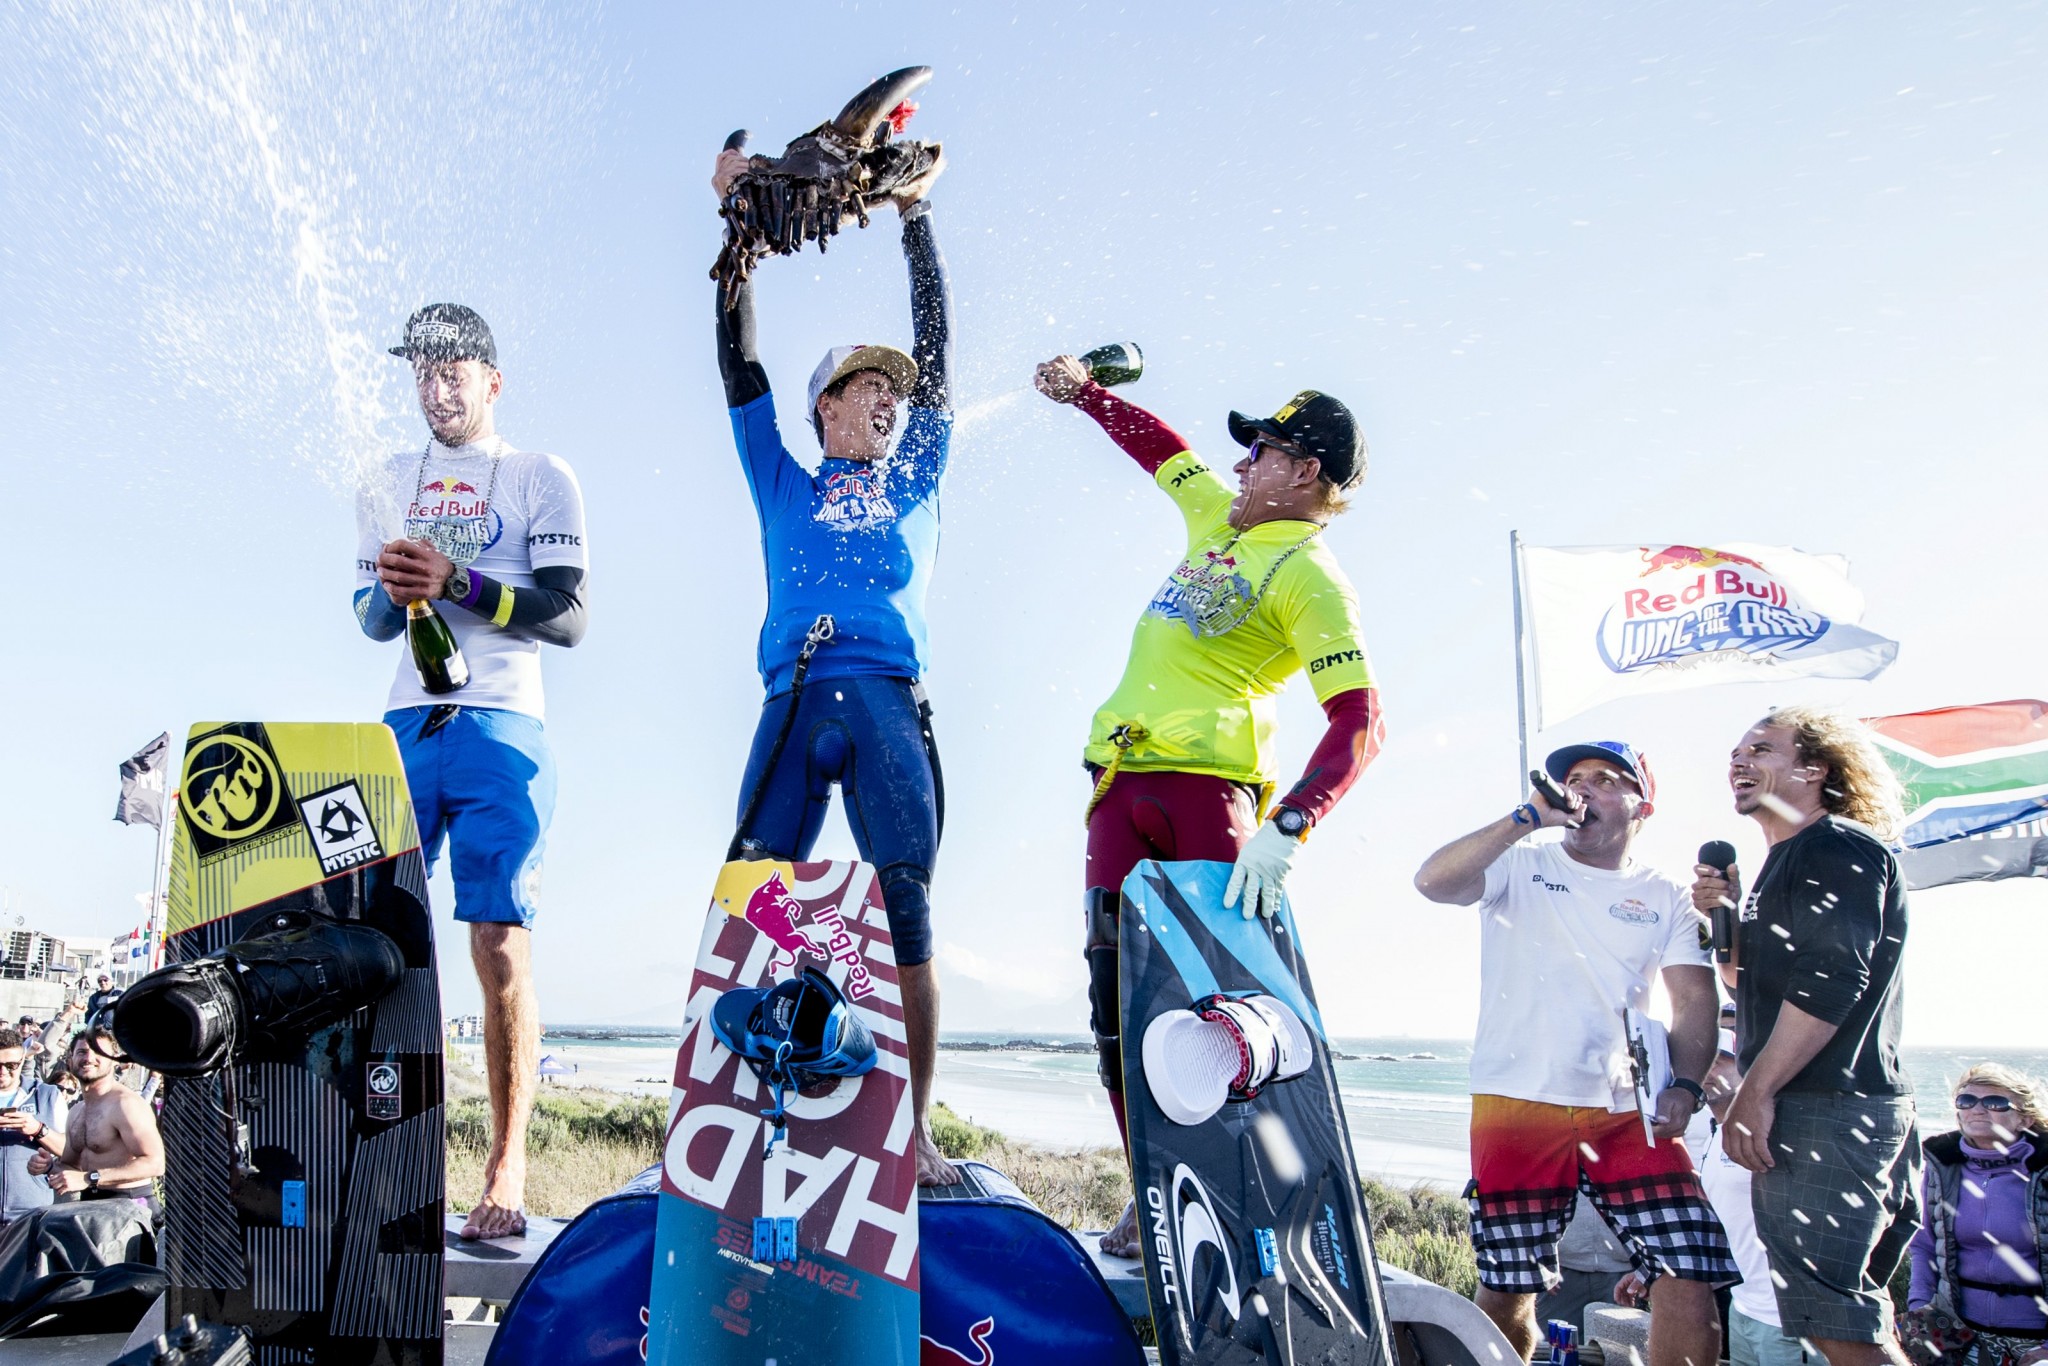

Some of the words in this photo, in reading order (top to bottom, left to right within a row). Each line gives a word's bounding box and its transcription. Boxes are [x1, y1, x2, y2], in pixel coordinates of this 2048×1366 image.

[1170, 464, 1210, 488] STIC
[408, 500, 444, 517] Red
[447, 500, 487, 517] Bull
[528, 533, 581, 546] MYSTIC
[1624, 574, 1706, 618] Red
[1714, 569, 1788, 609] Bull
[1696, 617, 1731, 639] THE
[1702, 602, 1727, 623] OF
[1738, 601, 1816, 638] AIR
[1617, 612, 1697, 671] KING
[322, 842, 381, 873] MYSTIC
[1542, 876, 1570, 893] YSTI
[812, 905, 853, 954] Bull
[834, 950, 876, 999] Red
[1147, 1186, 1178, 1305] O'NEILL
[1324, 1203, 1350, 1290] NAISH
